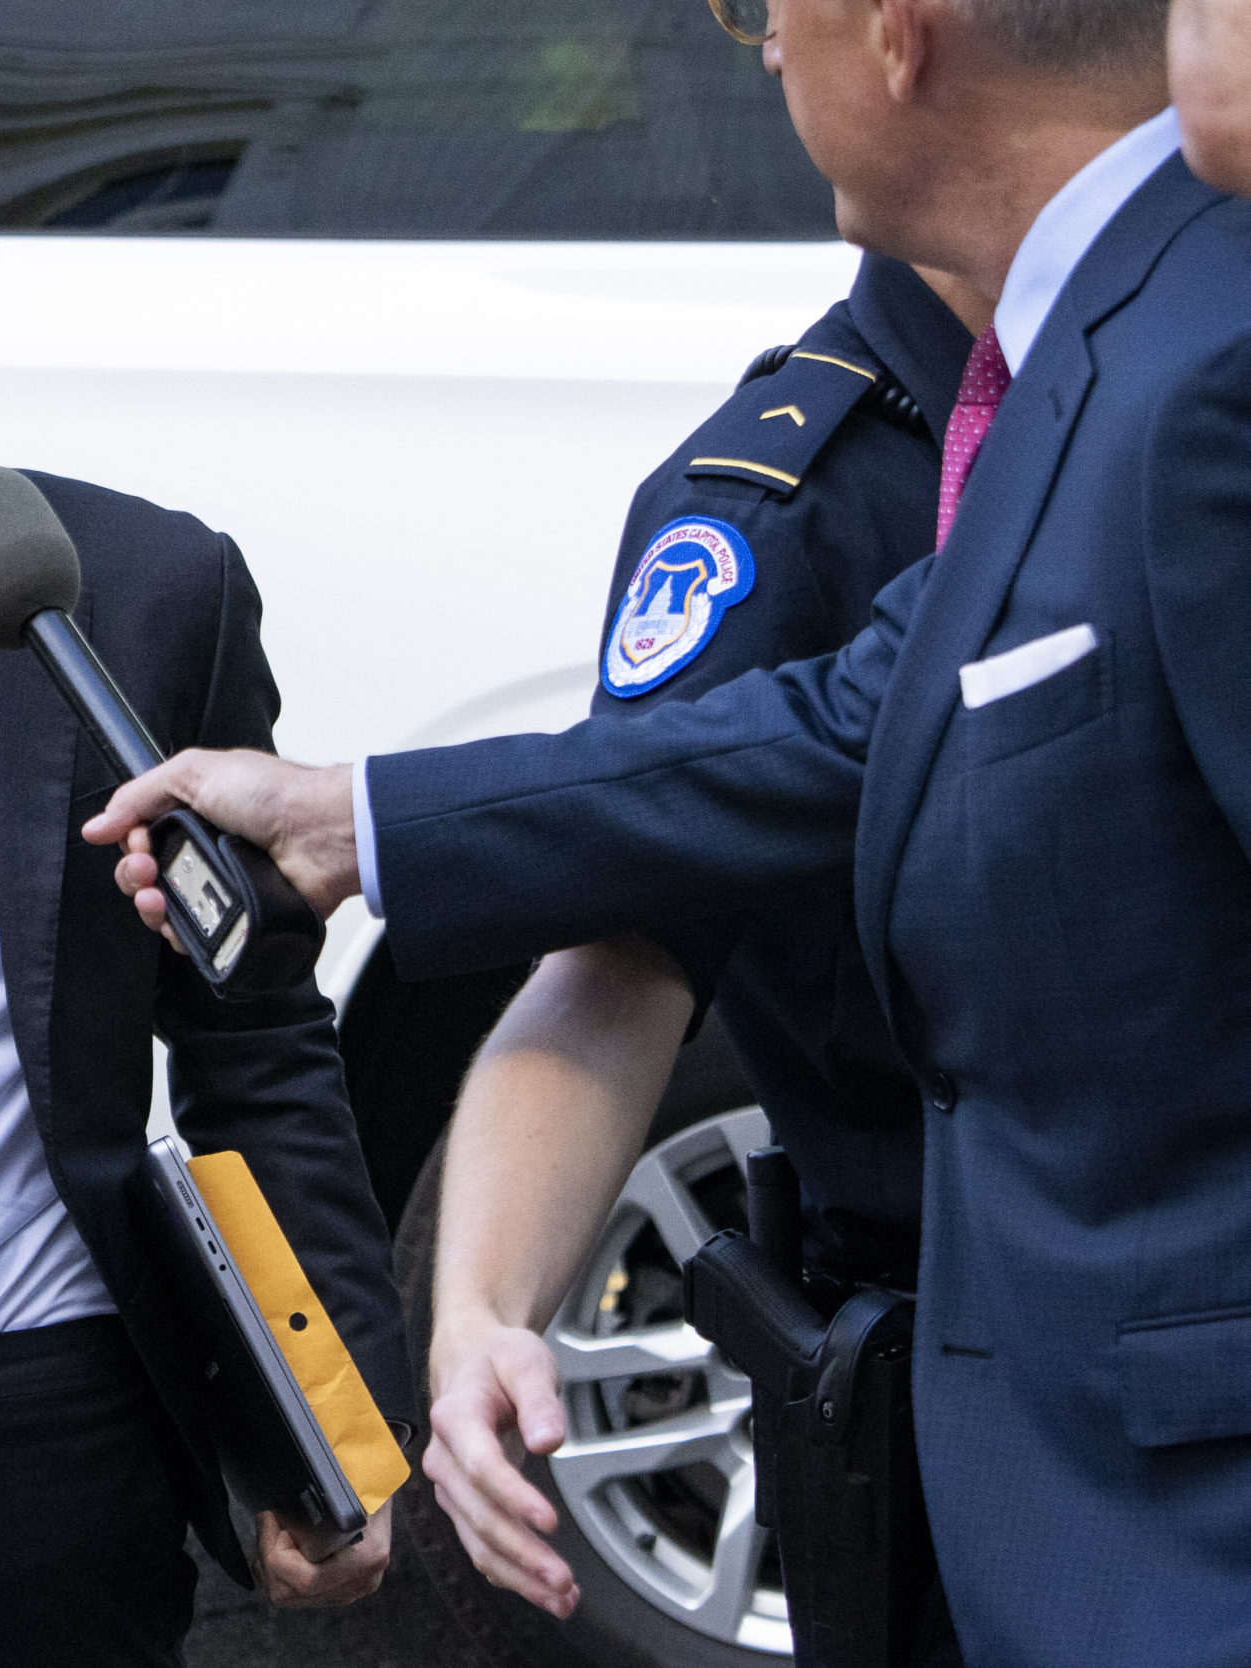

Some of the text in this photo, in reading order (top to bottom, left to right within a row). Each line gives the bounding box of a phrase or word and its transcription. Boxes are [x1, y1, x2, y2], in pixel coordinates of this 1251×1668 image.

[655, 528, 689, 552] STATES
[688, 528, 721, 555] CAPITOL
[716, 547, 734, 583] POLICE
